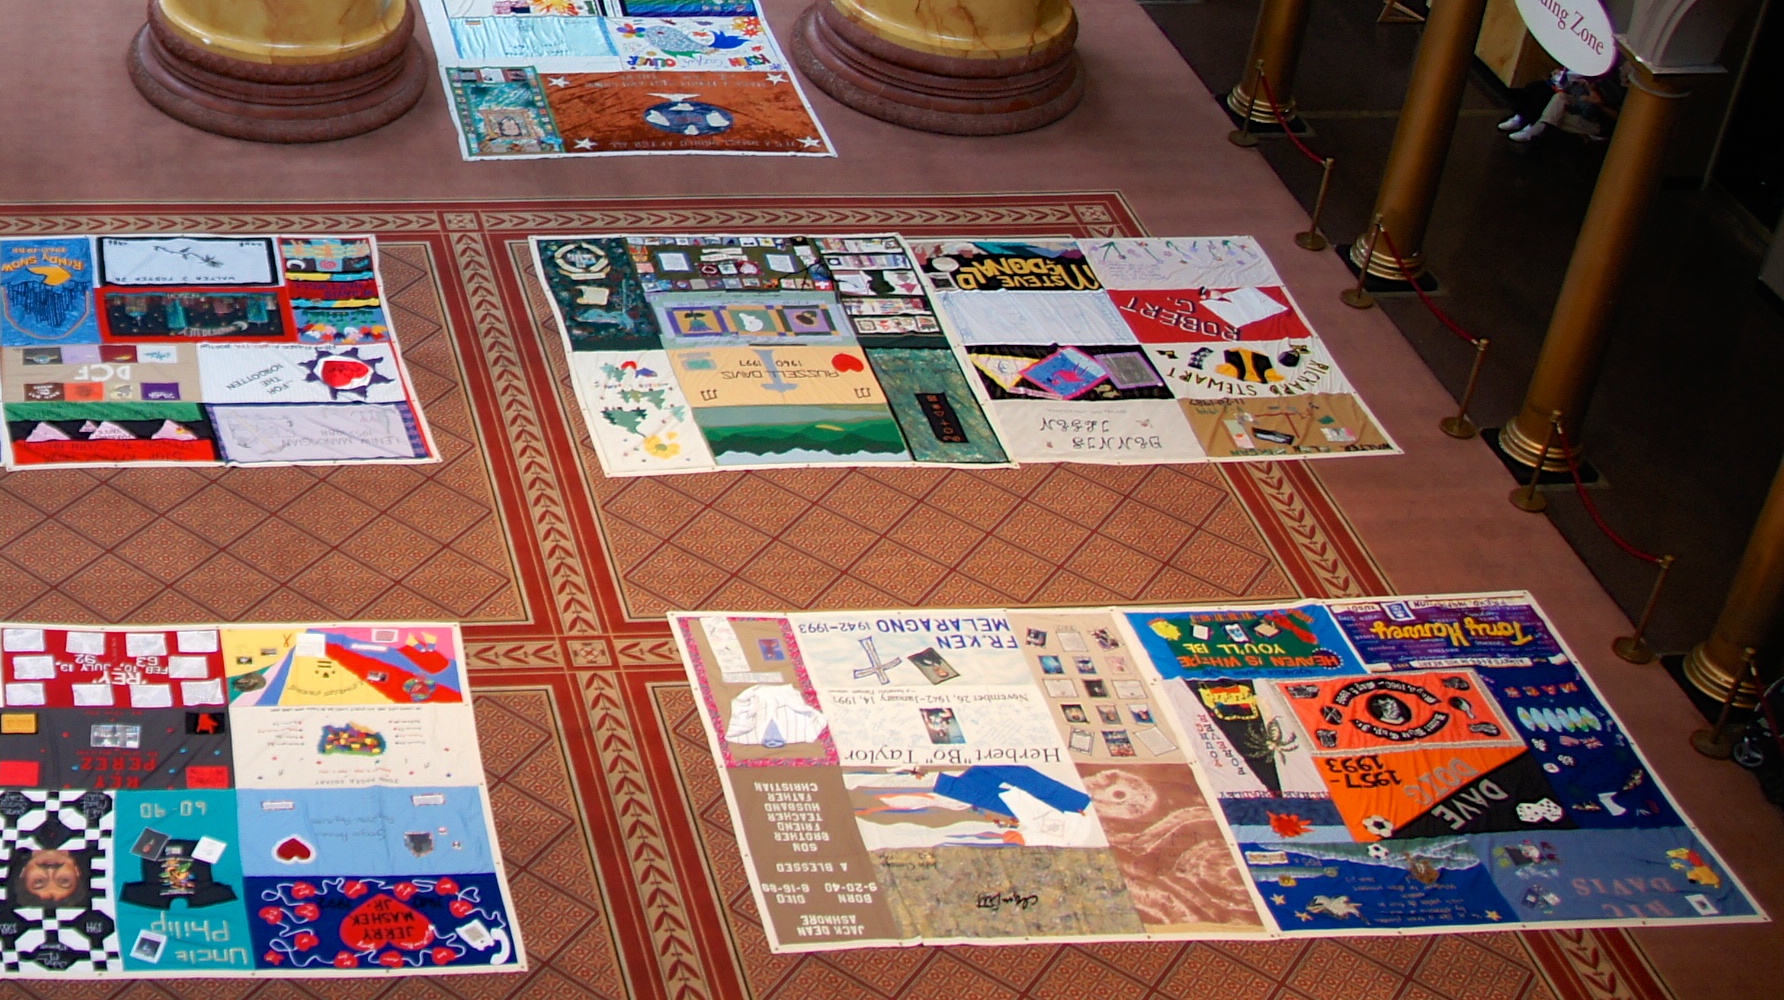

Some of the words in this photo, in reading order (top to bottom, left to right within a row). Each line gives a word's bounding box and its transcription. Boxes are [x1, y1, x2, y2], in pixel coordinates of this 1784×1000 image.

[1569, 11, 1606, 57] Zone
[0, 255, 39, 273] SNOW
[41, 250, 85, 271] RANDY
[1000, 275, 1064, 288] STEVE
[1119, 297, 1241, 342] ROBERT
[737, 358, 762, 367] 1997
[774, 358, 803, 367] 1960
[73, 363, 132, 383] DCF
[720, 370, 764, 380] DAVIS
[765, 370, 840, 380] RUSSELL
[1268, 360, 1330, 396] RICHARD
[258, 375, 282, 388] THE
[1165, 366, 1258, 397] STEWART
[798, 620, 873, 634] 1942-1993
[875, 618, 1010, 634] MELARAGNO
[1462, 616, 1533, 647] Tony
[1369, 620, 1471, 647] Harvey
[1182, 642, 1210, 655] BE
[1215, 642, 1286, 656] YOU'LL
[73, 653, 98, 666] 92
[135, 656, 160, 668] 63
[1175, 654, 1241, 669] WHERE
[1245, 655, 1264, 667] IS
[1269, 655, 1339, 669] HEAVEN
[80, 662, 113, 674] JULY
[972, 693, 1030, 704] November
[844, 743, 919, 765] Taylor
[925, 748, 972, 765] "Bo"
[975, 747, 1061, 763] Herbert
[80, 756, 158, 772] PEREZ
[1324, 755, 1386, 774] 1993
[94, 775, 142, 790] REY
[753, 781, 819, 792] CHRISTIAN
[766, 791, 814, 802] FATHER
[763, 801, 822, 812] HUSBAND
[1430, 778, 1510, 831] DAVE
[767, 811, 824, 822] TEACHER
[776, 821, 822, 832] FRIEND
[773, 831, 830, 841] BROTHER
[792, 842, 819, 852] SON
[775, 861, 834, 873] BLESSED
[839, 862, 849, 872] A
[823, 881, 878, 893] 9-20-40
[1570, 877, 1677, 897] DAVIS
[774, 893, 807, 905] DIED
[837, 893, 875, 905] BORN
[347, 909, 416, 927] MASHEK
[799, 914, 857, 926] ASHMORE
[149, 910, 231, 943] Philip
[795, 925, 831, 938] DEAN
[832, 924, 866, 937] JACK
[361, 925, 416, 942] JERRY
